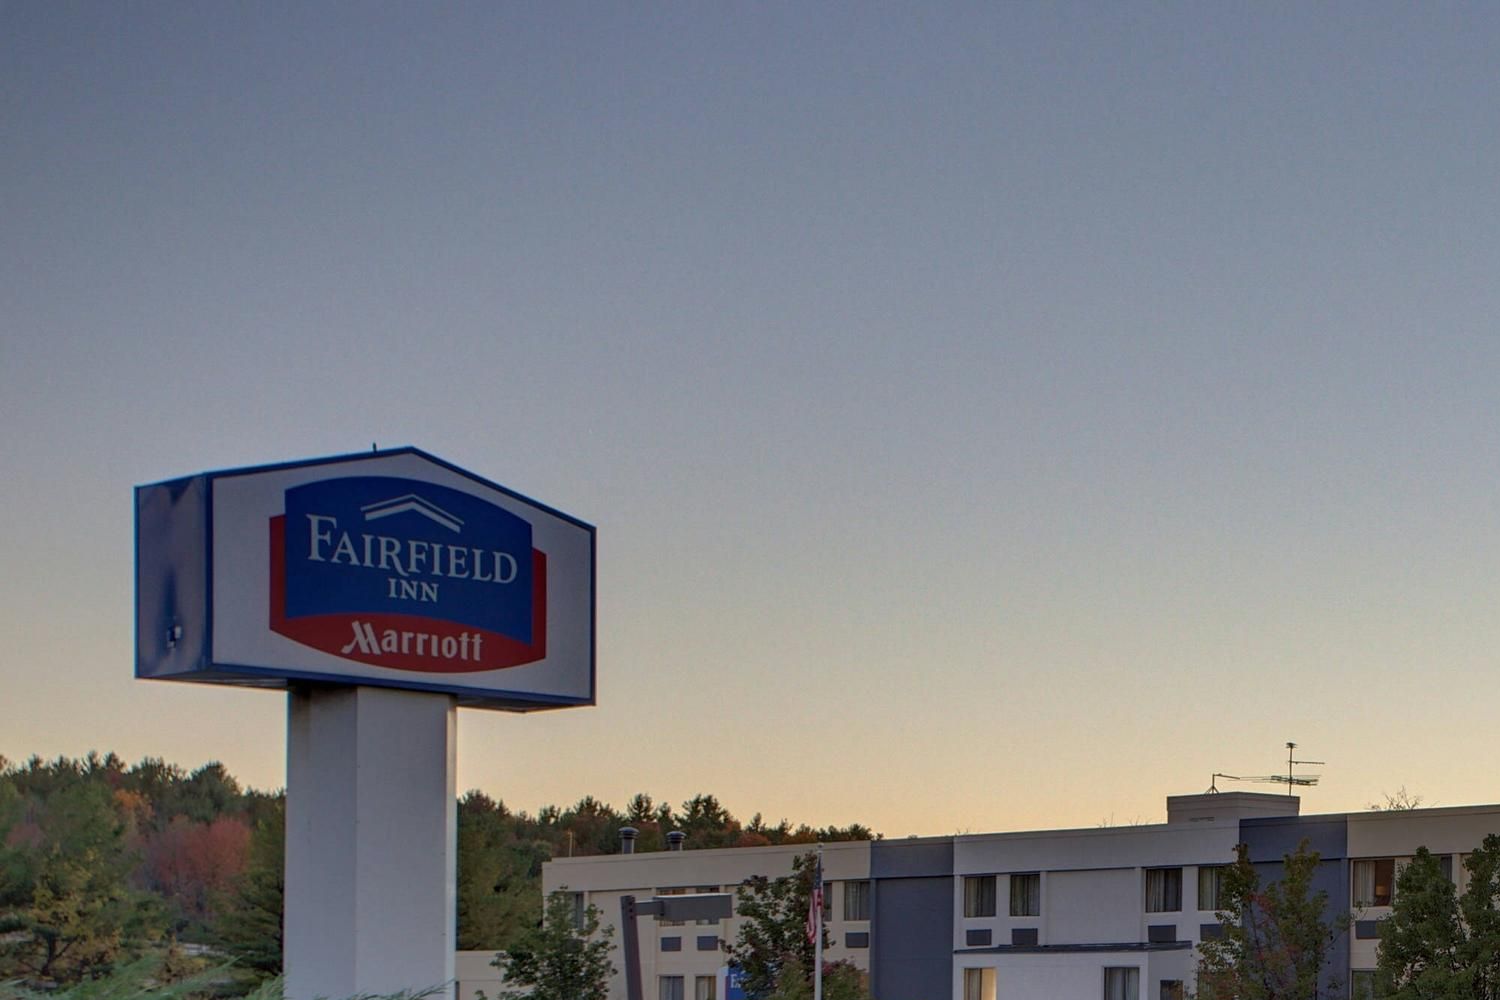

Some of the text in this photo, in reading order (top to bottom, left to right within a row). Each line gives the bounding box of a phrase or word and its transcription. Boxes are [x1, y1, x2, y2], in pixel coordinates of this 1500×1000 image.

[305, 513, 518, 584] FAIRFIELD
[388, 578, 439, 602] INN
[341, 620, 482, 661] Marriott
